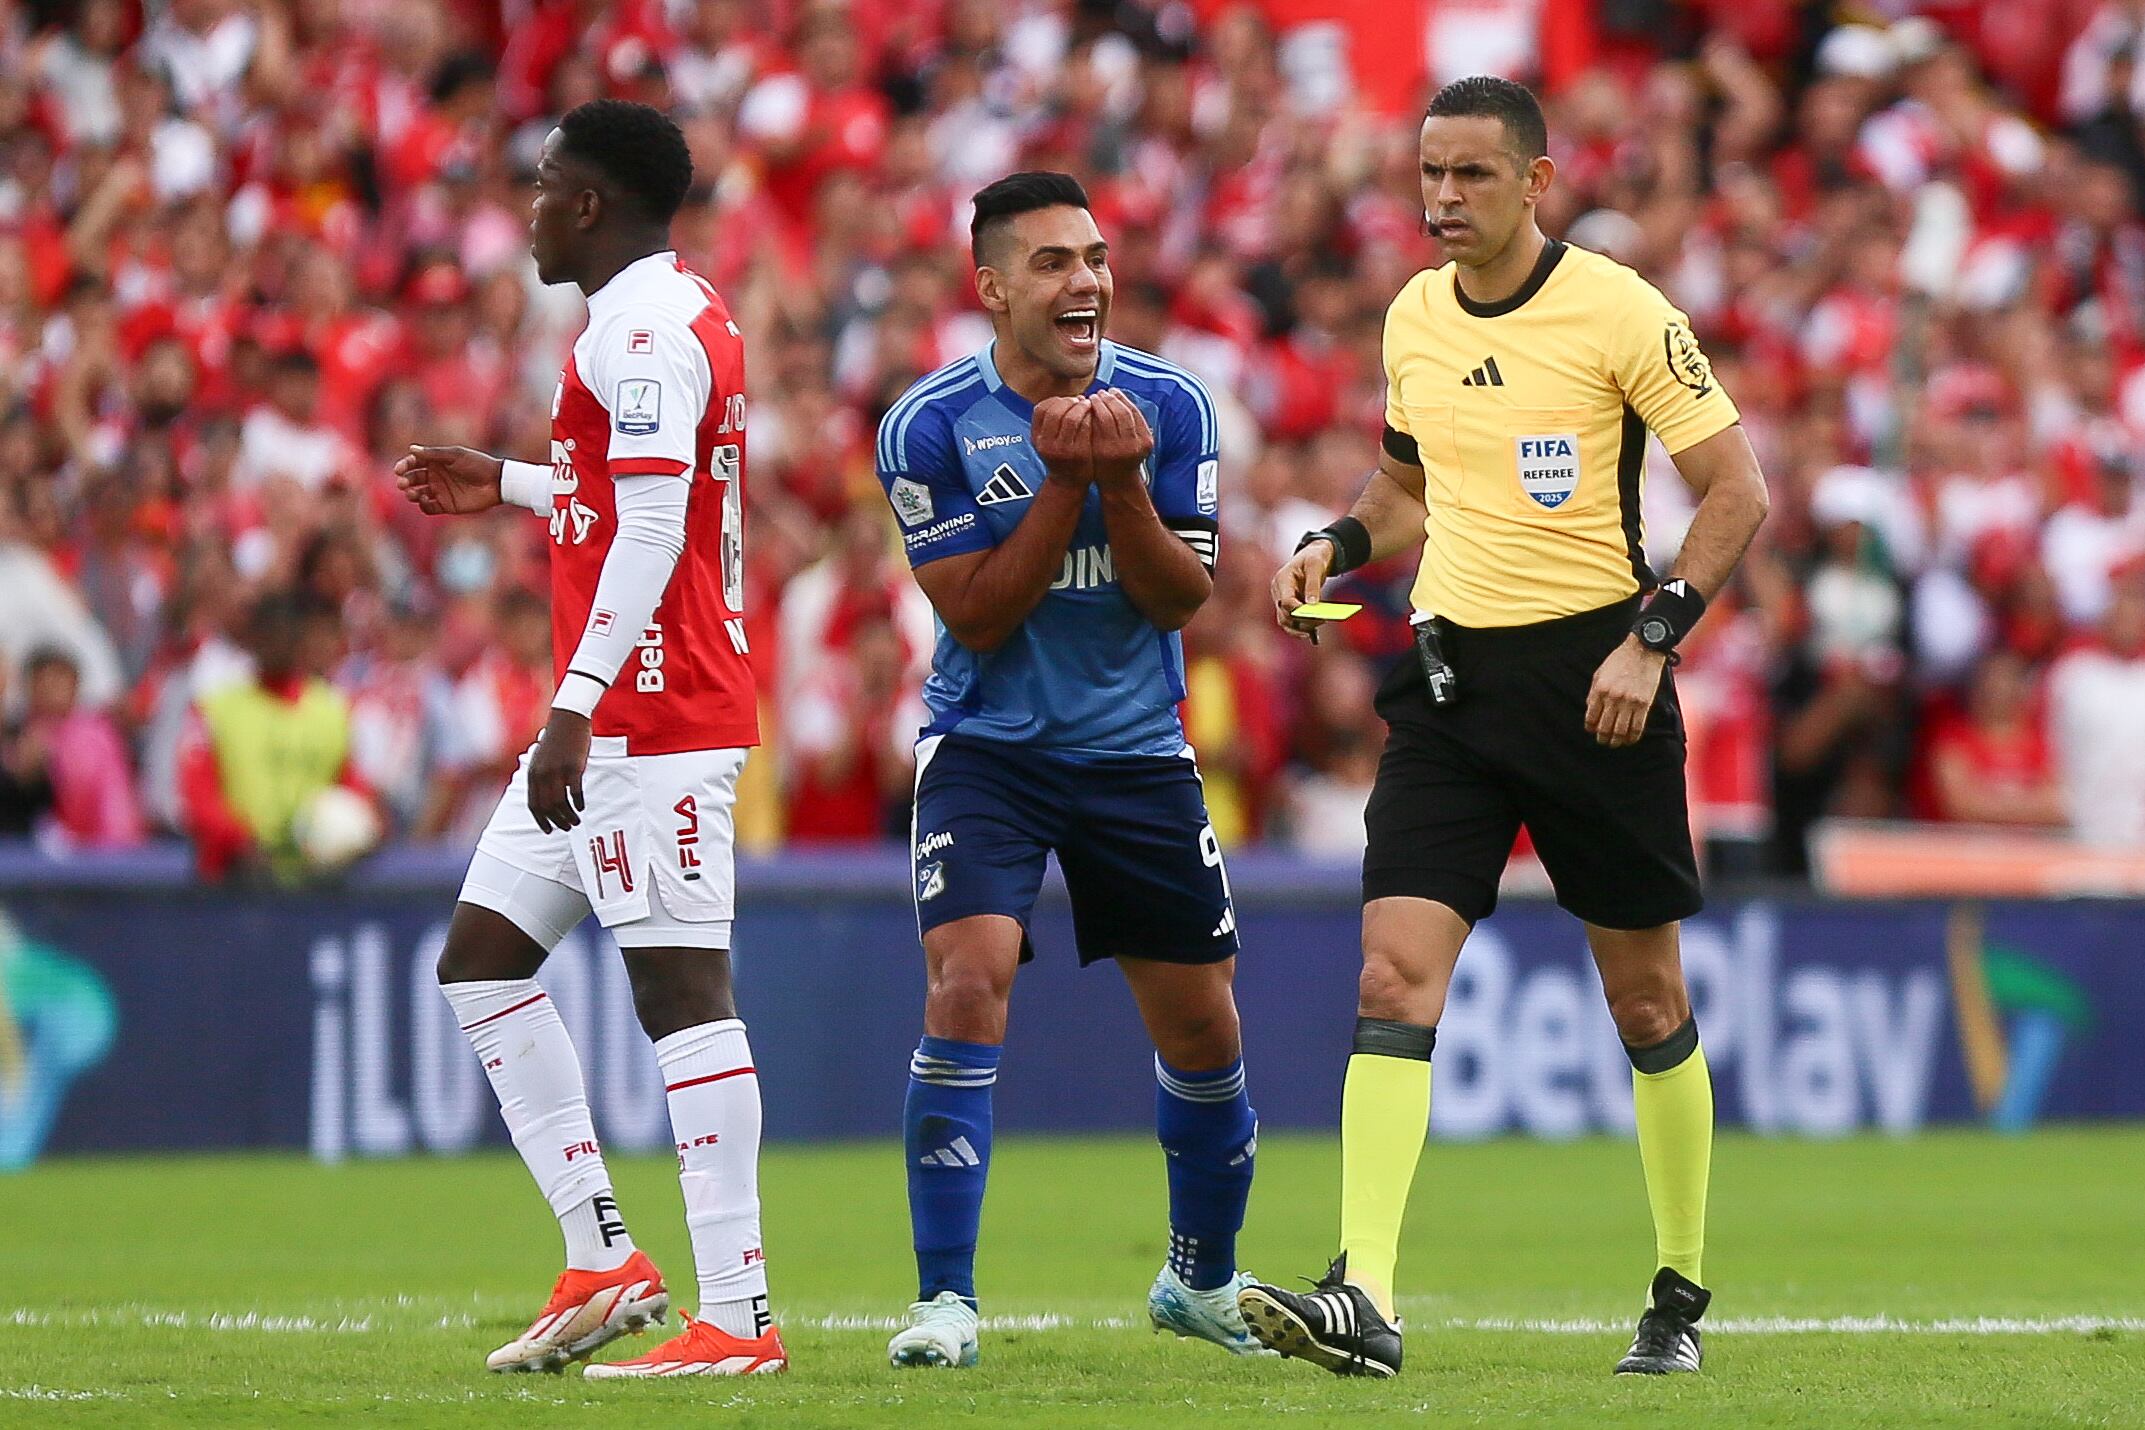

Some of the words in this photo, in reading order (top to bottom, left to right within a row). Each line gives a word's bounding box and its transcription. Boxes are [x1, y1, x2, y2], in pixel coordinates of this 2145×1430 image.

[1521, 439, 1573, 459] FIFA
[1523, 468, 1575, 481] REFEREE
[1539, 493, 1563, 503] 2025
[673, 795, 701, 869] FILA
[589, 829, 635, 900] 14
[1199, 823, 1229, 899] 9
[563, 1141, 602, 1162] FIL
